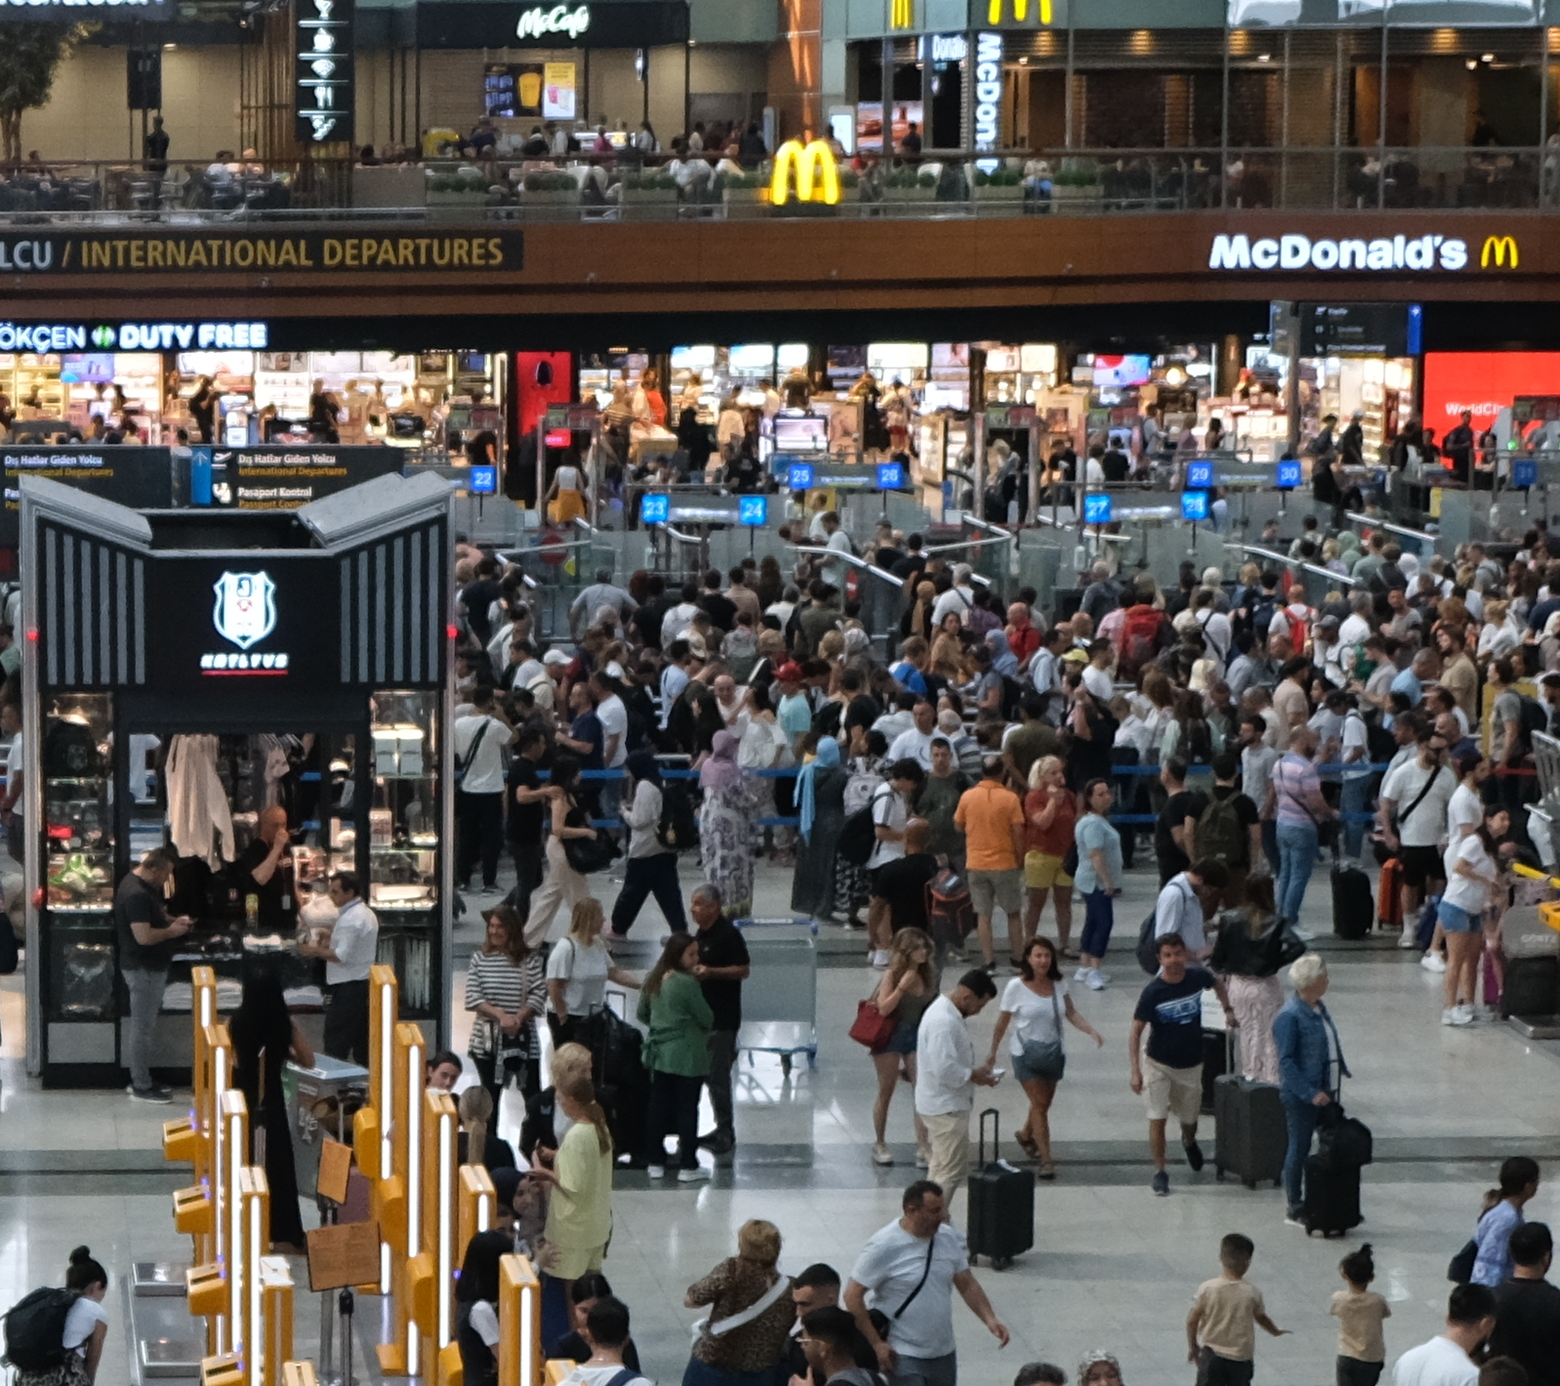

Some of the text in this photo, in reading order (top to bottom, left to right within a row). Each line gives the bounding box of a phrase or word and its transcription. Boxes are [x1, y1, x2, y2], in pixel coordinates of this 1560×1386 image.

[81, 239, 312, 268] INTERNATIONAL
[322, 237, 504, 268] DEPARTURES
[120, 325, 194, 349] DUTY
[198, 325, 267, 349] FREE
